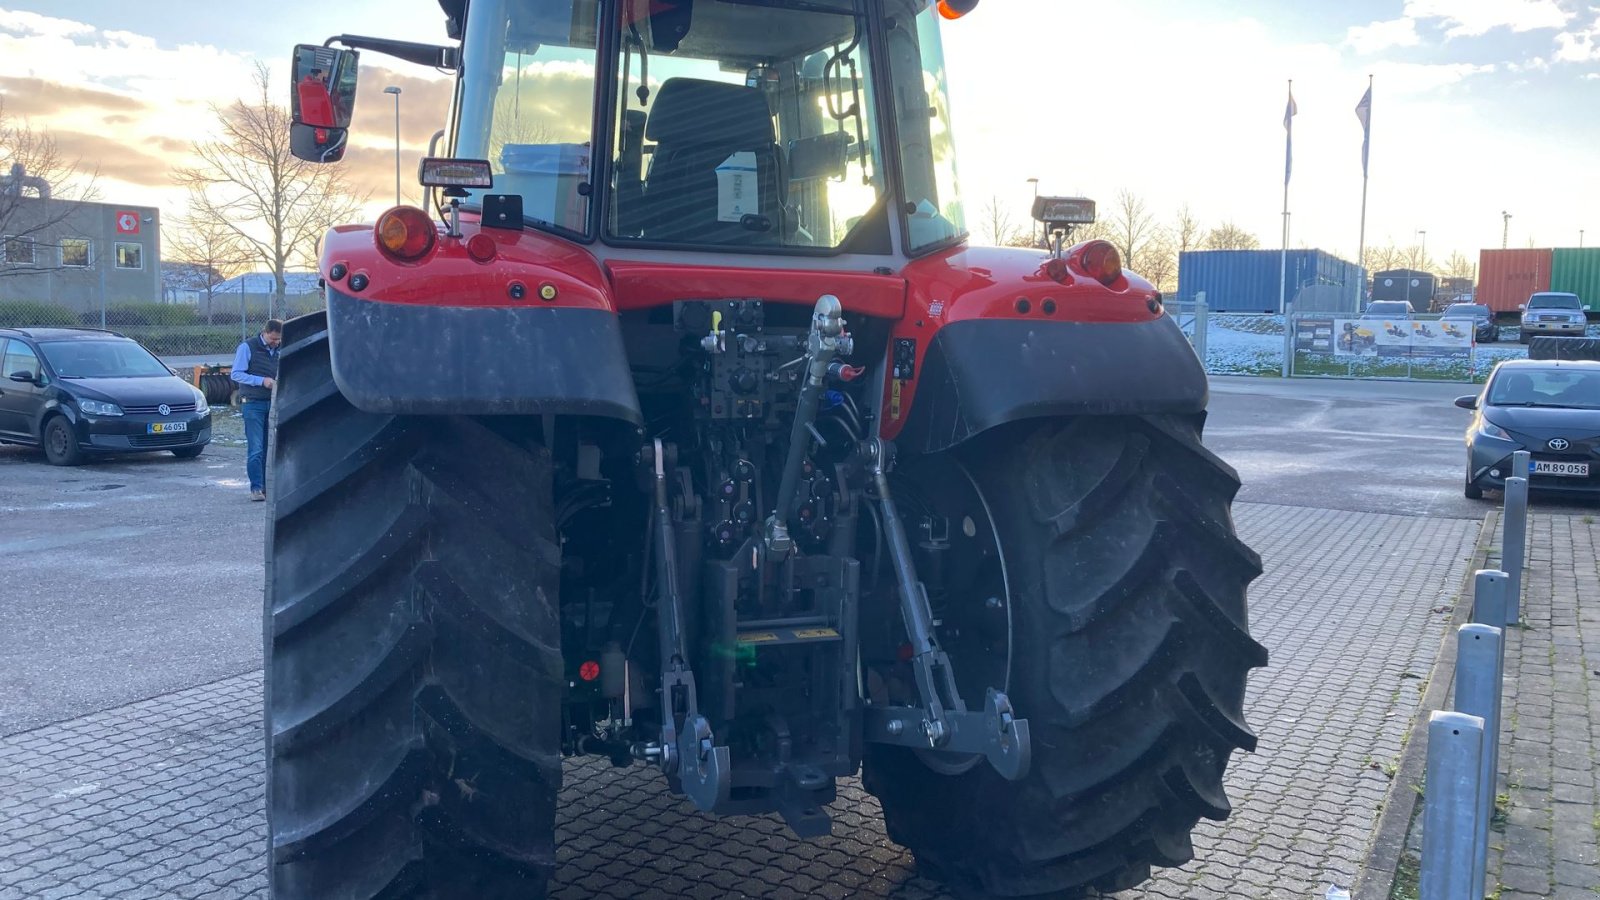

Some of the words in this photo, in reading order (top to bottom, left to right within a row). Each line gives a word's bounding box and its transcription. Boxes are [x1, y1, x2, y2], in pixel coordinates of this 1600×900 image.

[173, 422, 186, 431] 051
[1536, 463, 1551, 472] AM
[1552, 463, 1565, 473] 89
[1567, 464, 1587, 474] 058
